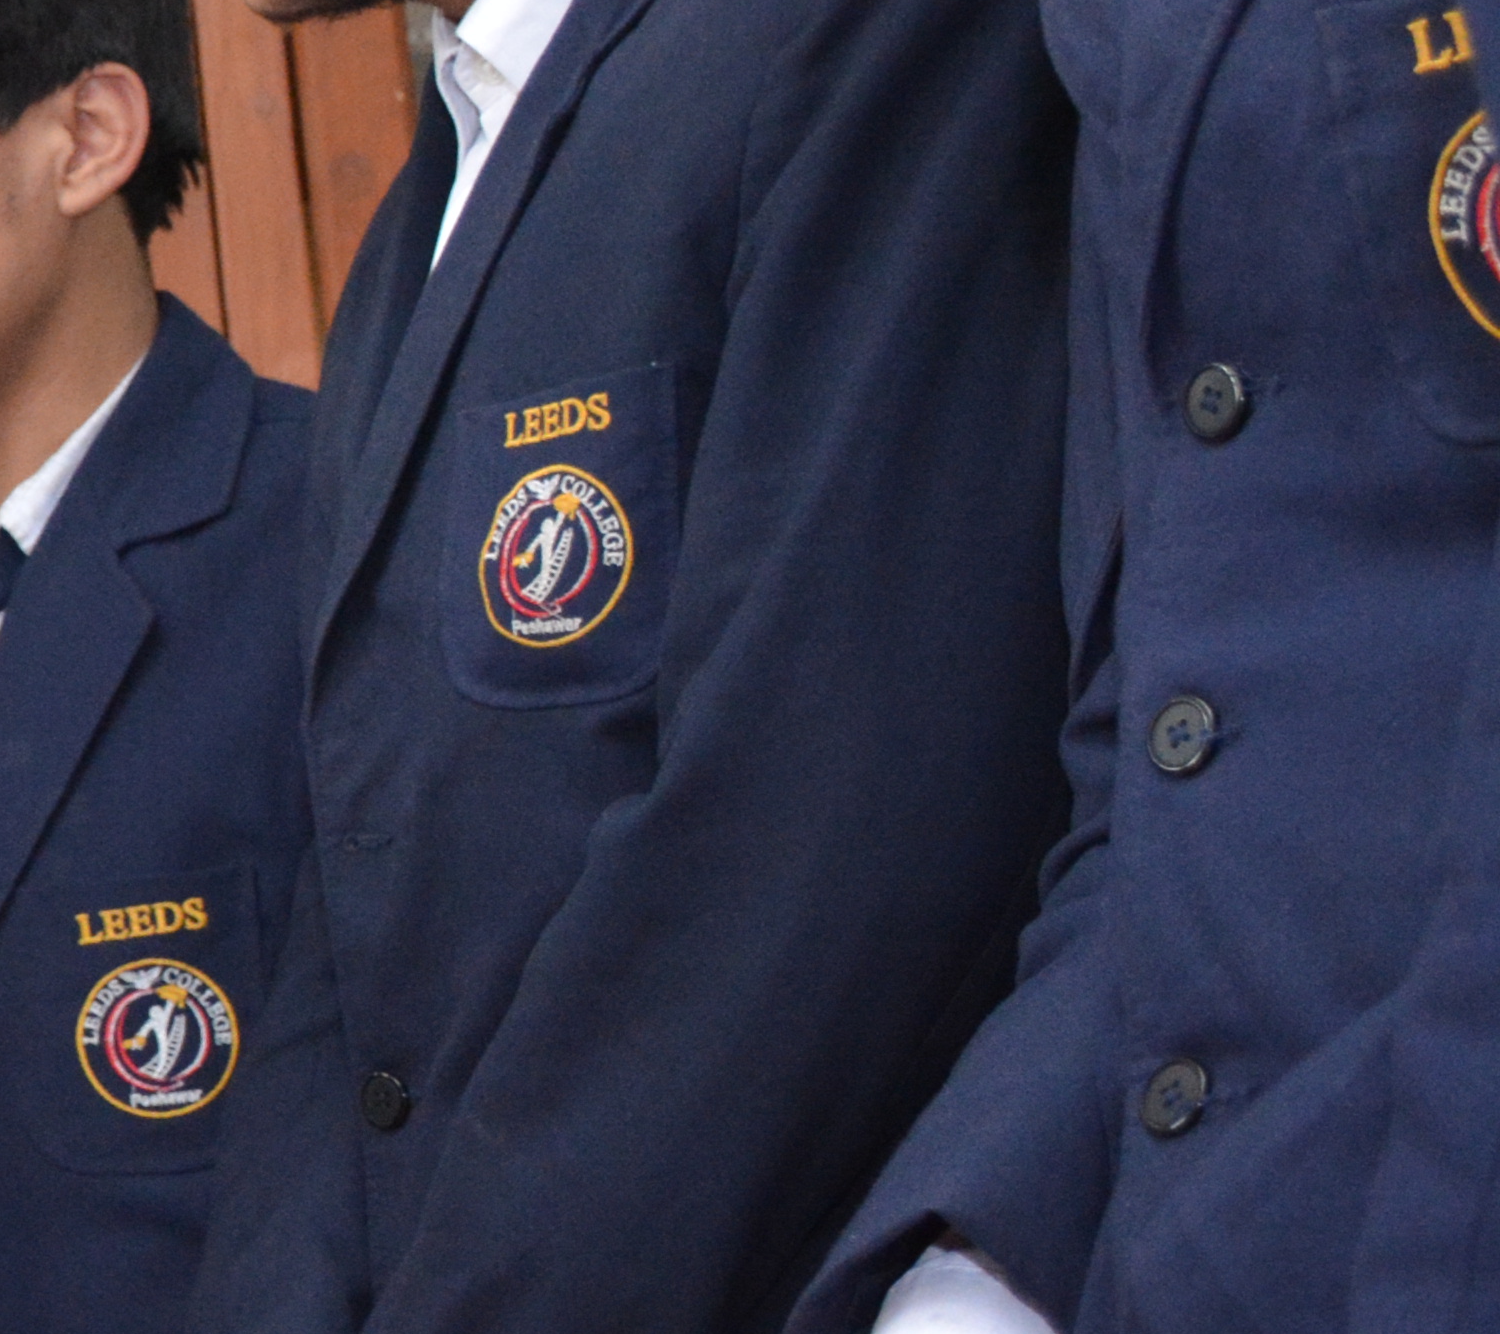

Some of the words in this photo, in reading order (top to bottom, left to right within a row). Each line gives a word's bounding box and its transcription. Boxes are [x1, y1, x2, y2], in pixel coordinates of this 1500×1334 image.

[504, 392, 613, 448] LEEDS
[484, 487, 530, 561] LEEDS
[560, 474, 625, 567] COLLEGE
[75, 896, 209, 946] LEEDS
[82, 978, 127, 1046] LEEDS
[163, 967, 232, 1046] COLLEGE
